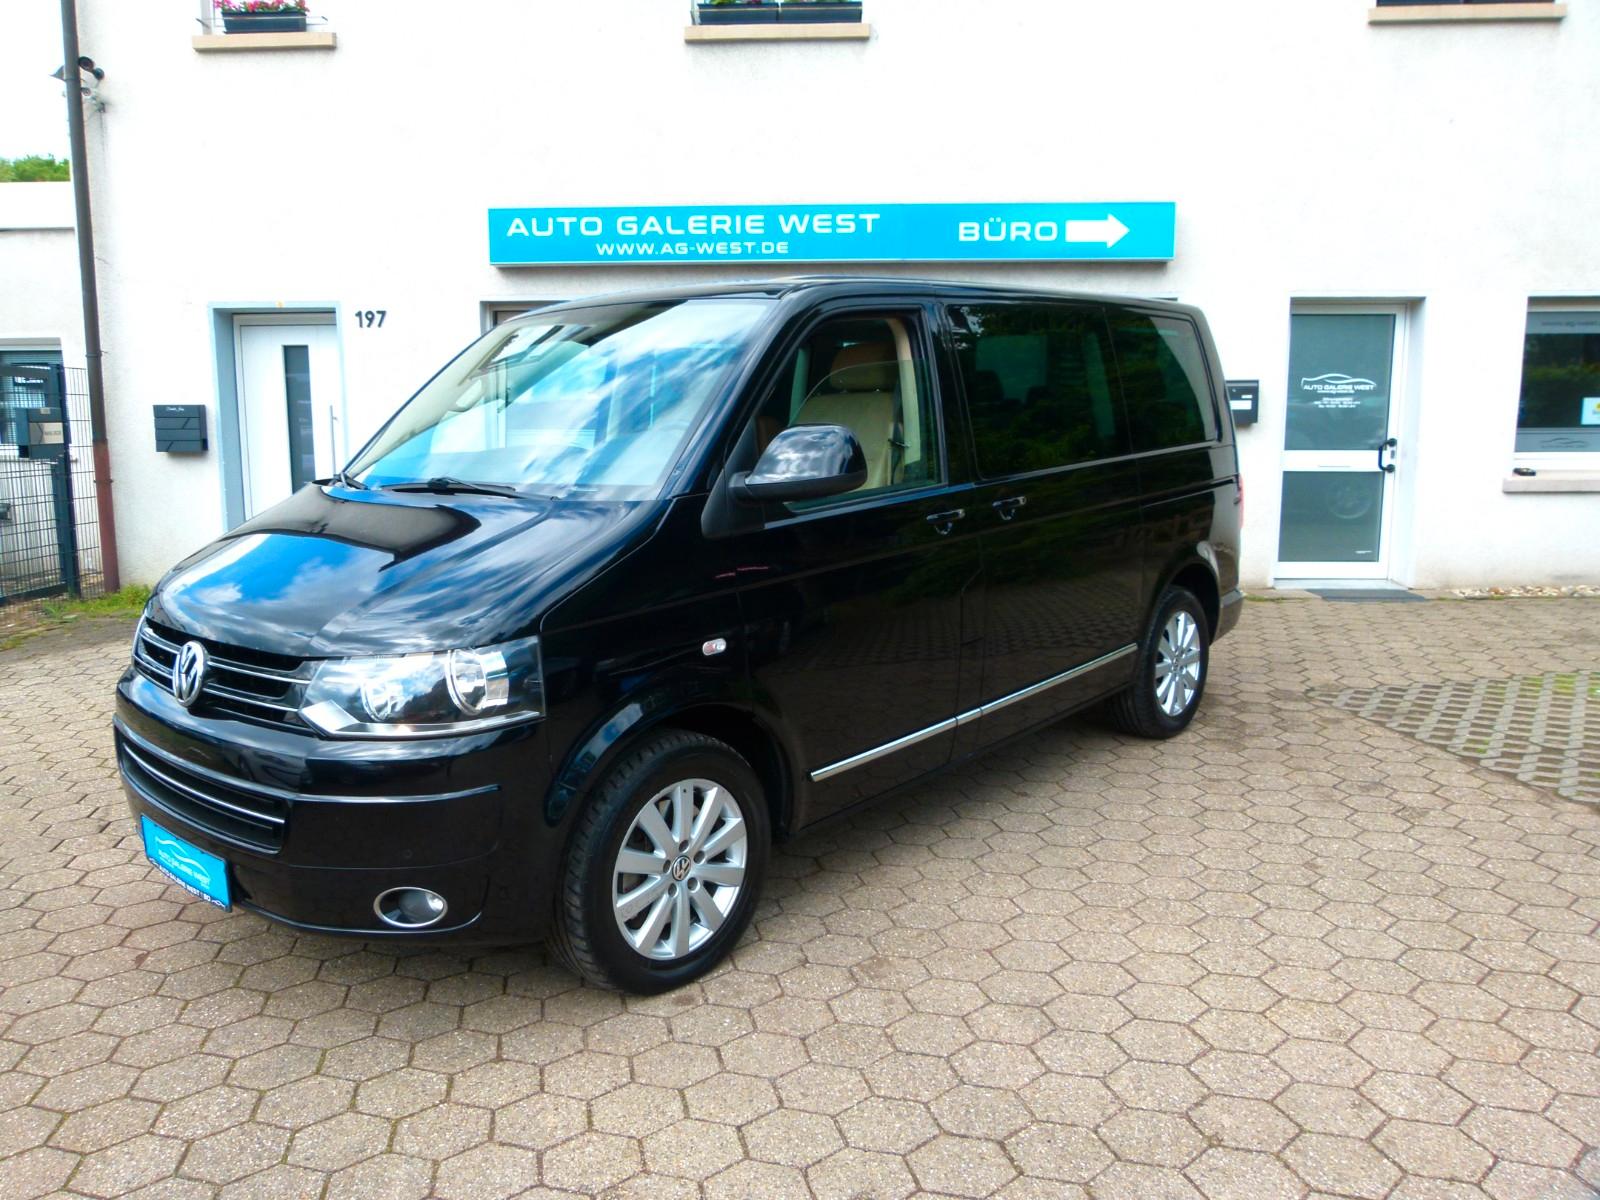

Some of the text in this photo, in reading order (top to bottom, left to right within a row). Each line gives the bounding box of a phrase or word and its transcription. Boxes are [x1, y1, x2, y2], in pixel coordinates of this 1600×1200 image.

[507, 213, 881, 237] AUTO GALERIE WEST
[958, 217, 1059, 242] BÜRO
[596, 241, 789, 256] WWW.AG-WEST.DE
[354, 310, 387, 328] 197
